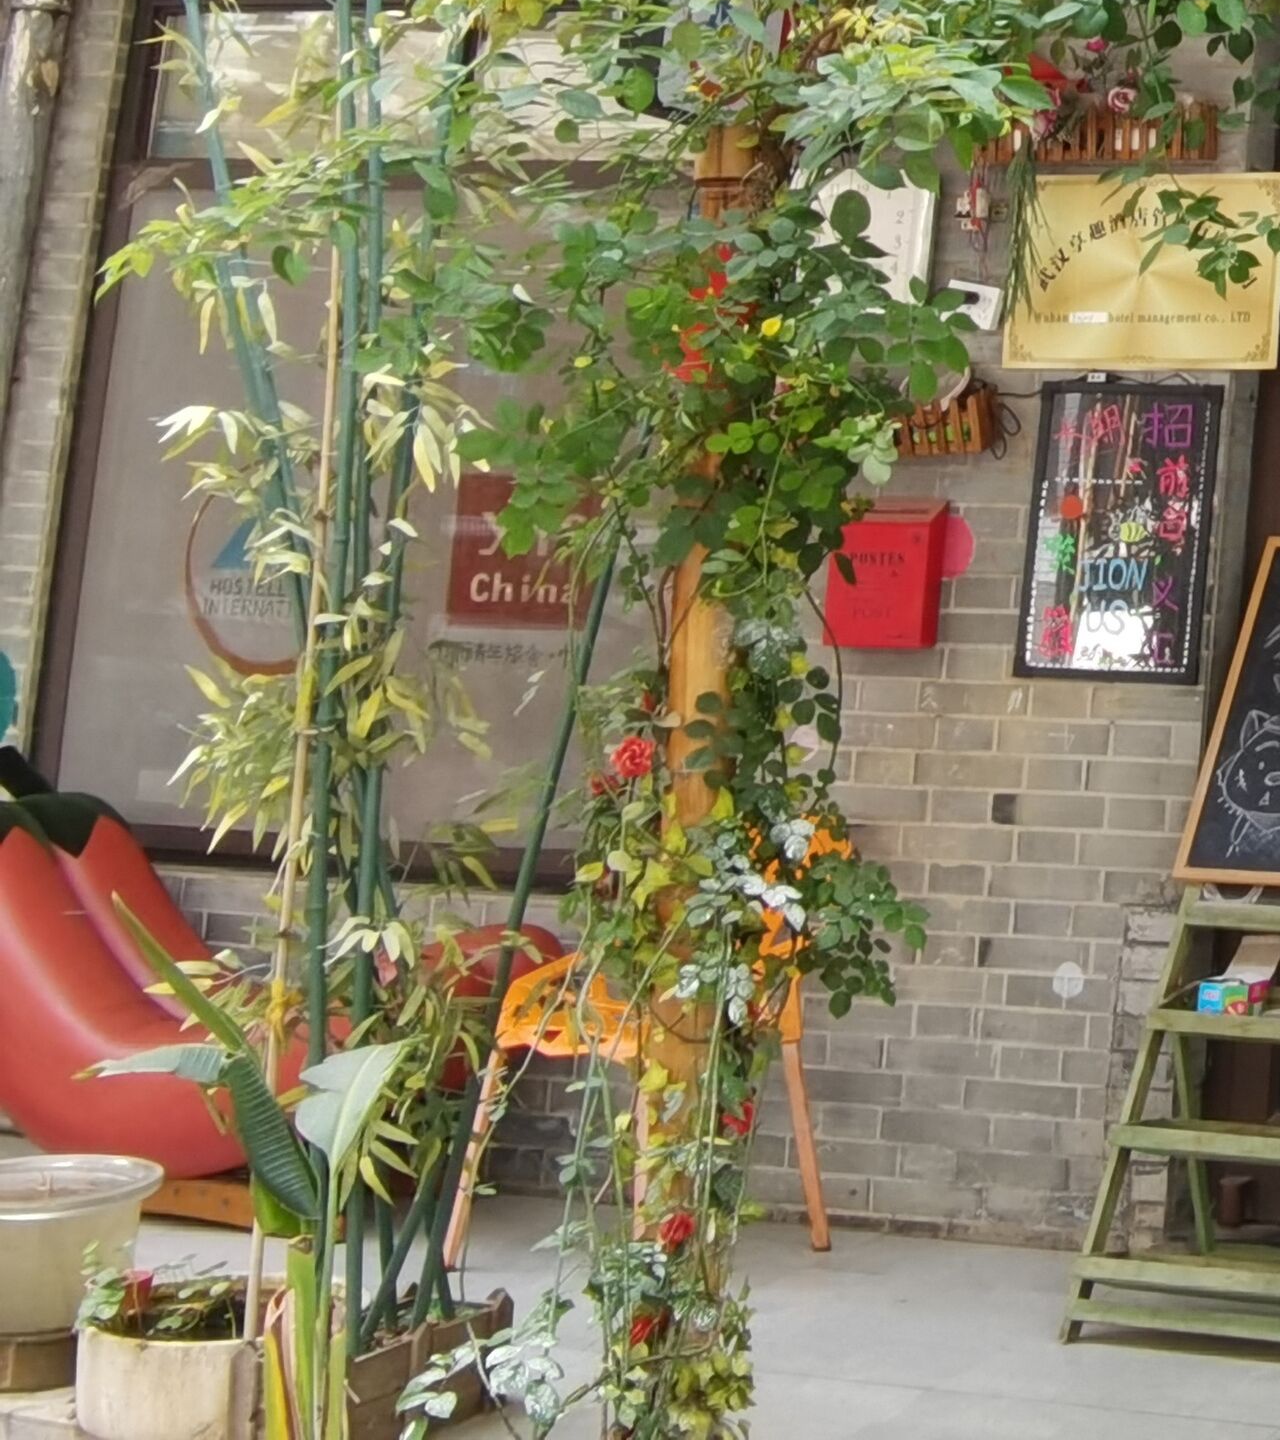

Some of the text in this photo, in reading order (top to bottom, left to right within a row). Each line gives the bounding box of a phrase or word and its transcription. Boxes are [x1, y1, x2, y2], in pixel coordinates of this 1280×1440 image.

[470, 572, 578, 604] China
[1079, 558, 1148, 592] JION
[1085, 599, 1129, 635] US
